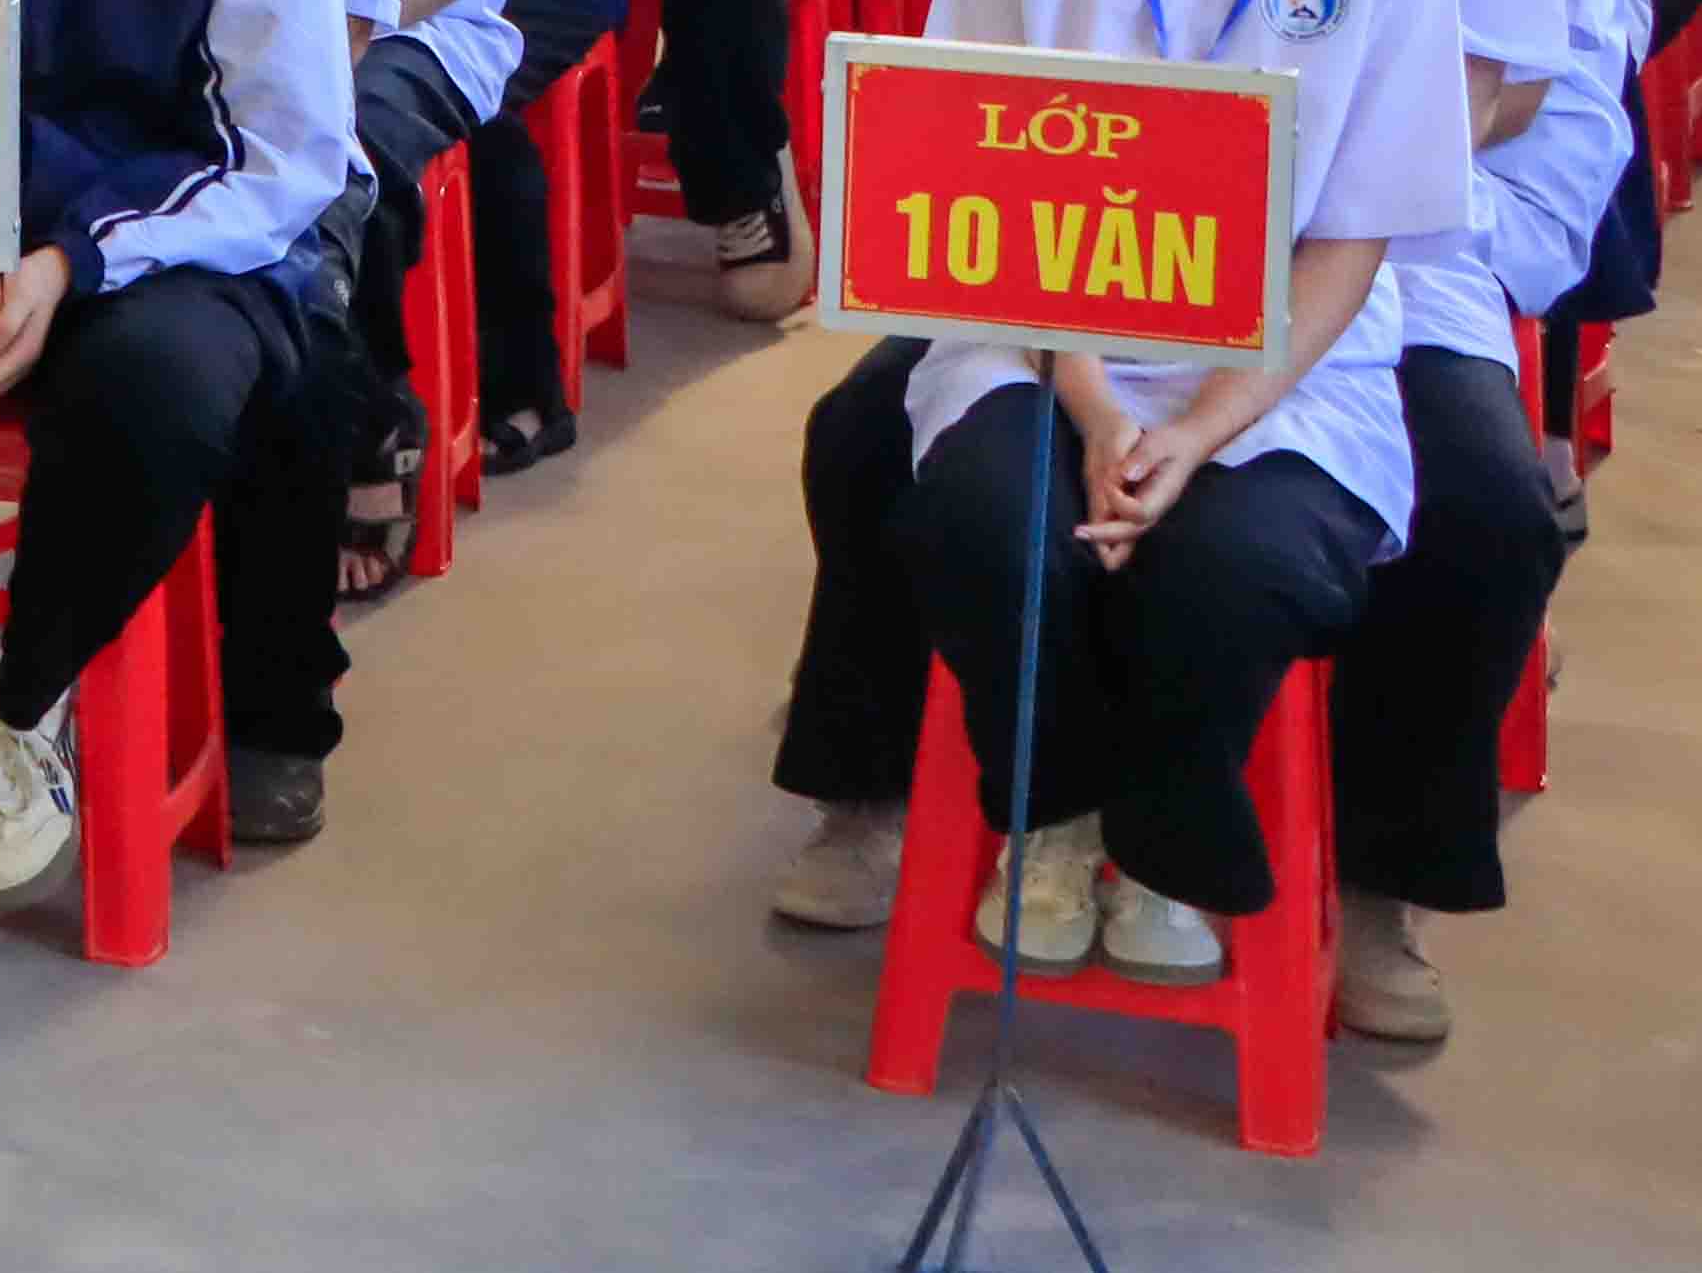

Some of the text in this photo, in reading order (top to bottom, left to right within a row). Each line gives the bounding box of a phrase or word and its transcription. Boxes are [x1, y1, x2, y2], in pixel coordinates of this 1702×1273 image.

[976, 93, 1142, 159] LỚP
[895, 186, 1218, 307] 10 VĂN
